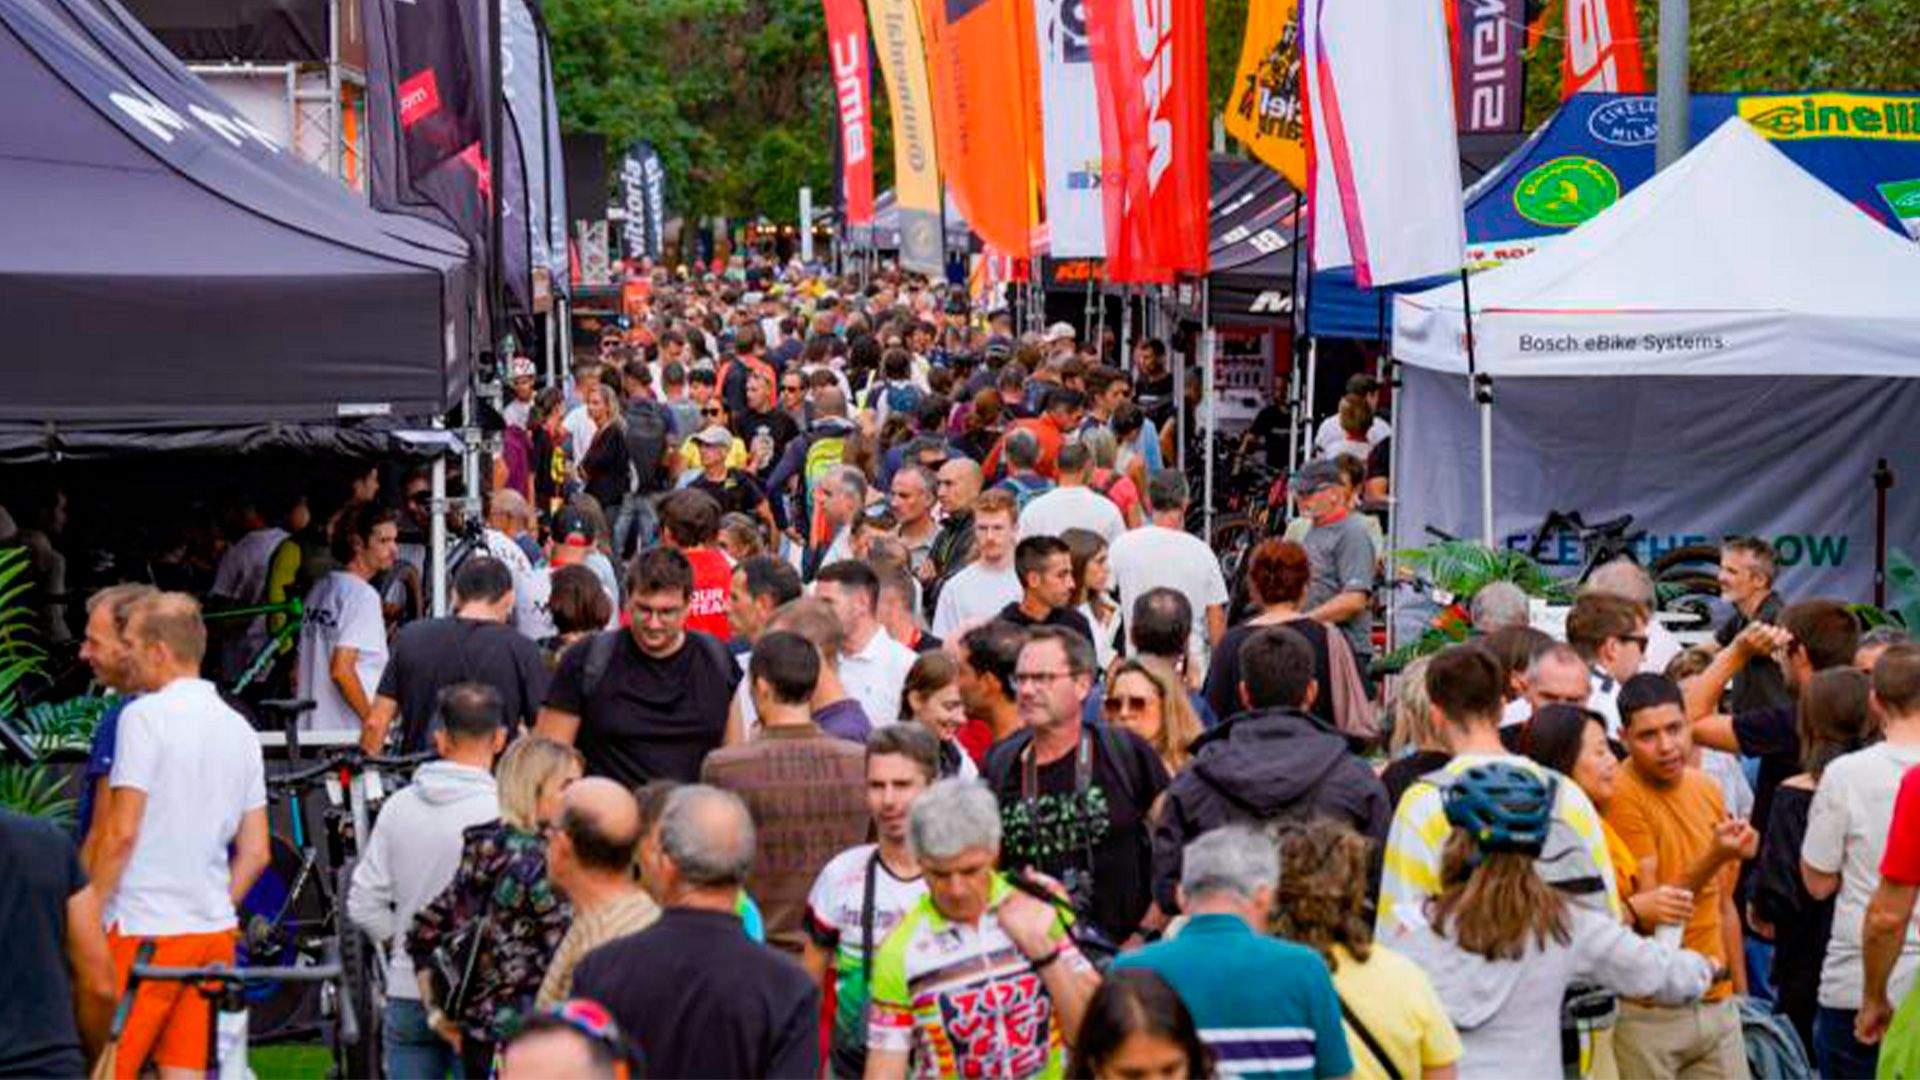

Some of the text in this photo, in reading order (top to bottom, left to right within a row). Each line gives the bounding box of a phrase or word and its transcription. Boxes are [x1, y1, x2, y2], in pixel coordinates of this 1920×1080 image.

[620, 154, 645, 257] vittoria
[1519, 333, 1724, 354] Bosch eBike Systems
